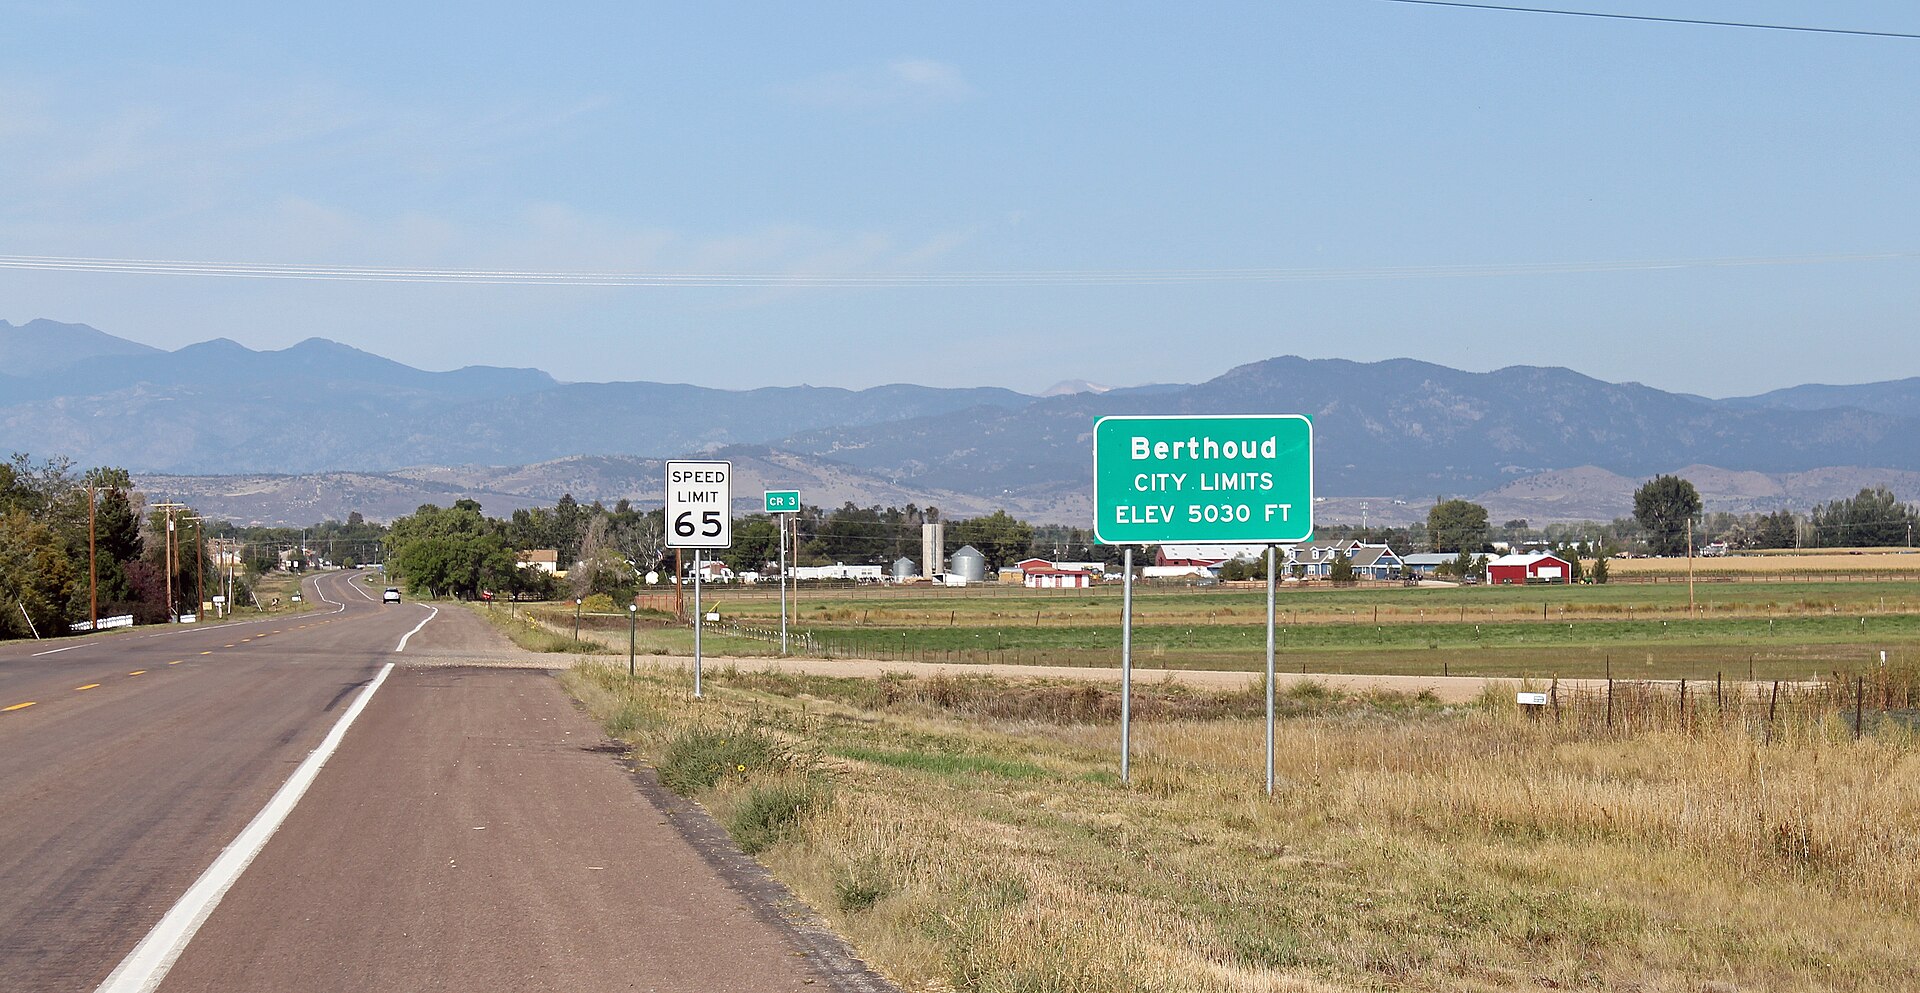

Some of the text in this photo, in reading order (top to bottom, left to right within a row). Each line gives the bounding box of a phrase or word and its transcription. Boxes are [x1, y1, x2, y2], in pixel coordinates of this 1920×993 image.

[1131, 436, 1276, 460] Berthoud
[672, 471, 725, 483] SPEED
[1134, 472, 1274, 492] CITY LIMITS
[677, 491, 719, 503] LIMIT
[769, 496, 796, 506] CR 3
[1116, 504, 1292, 523] ELEV 5030 FT
[674, 510, 722, 537] 65
